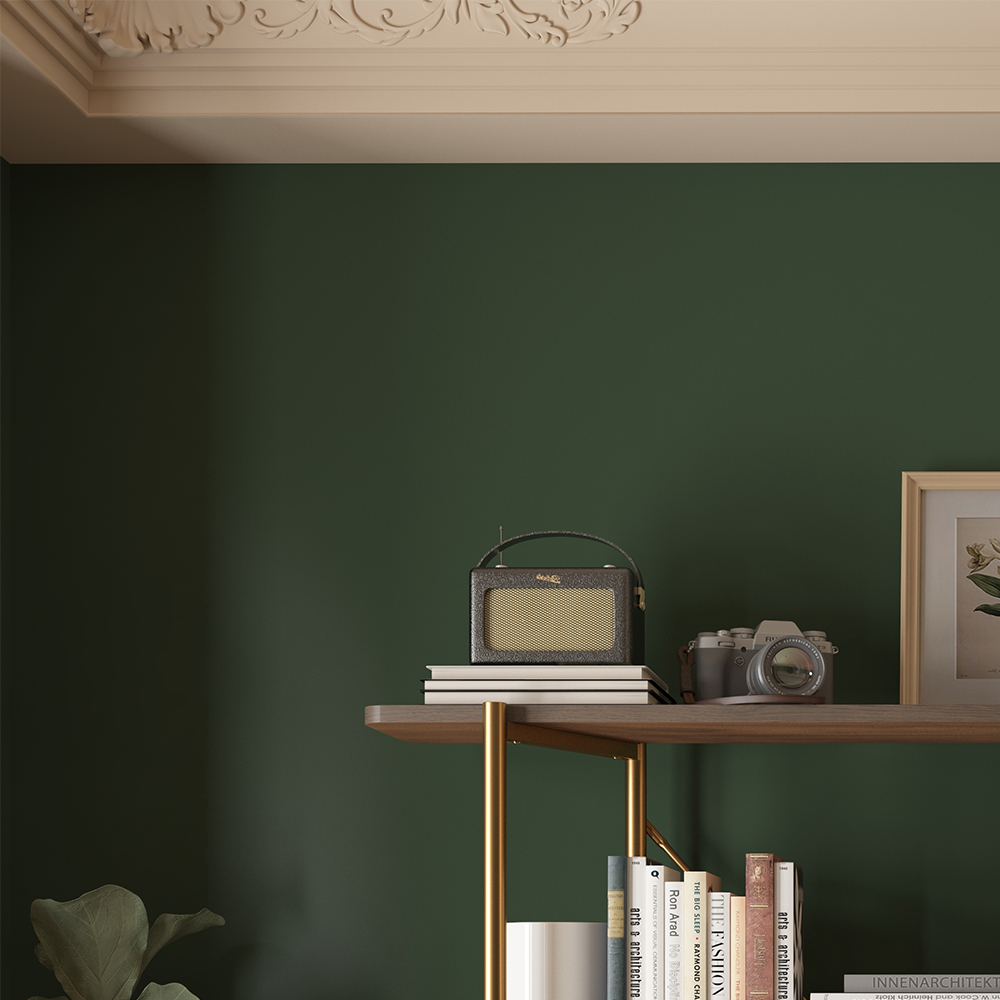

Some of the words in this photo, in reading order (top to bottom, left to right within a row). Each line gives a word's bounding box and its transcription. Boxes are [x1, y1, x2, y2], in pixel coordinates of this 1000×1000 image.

[668, 889, 680, 910] Ron
[710, 894, 724, 927] THE
[630, 907, 641, 926] arts
[668, 912, 680, 937] Arad
[777, 911, 789, 929] arts
[630, 941, 642, 997] architecture
[710, 930, 724, 996] FASHION
[777, 944, 790, 999] architecture
